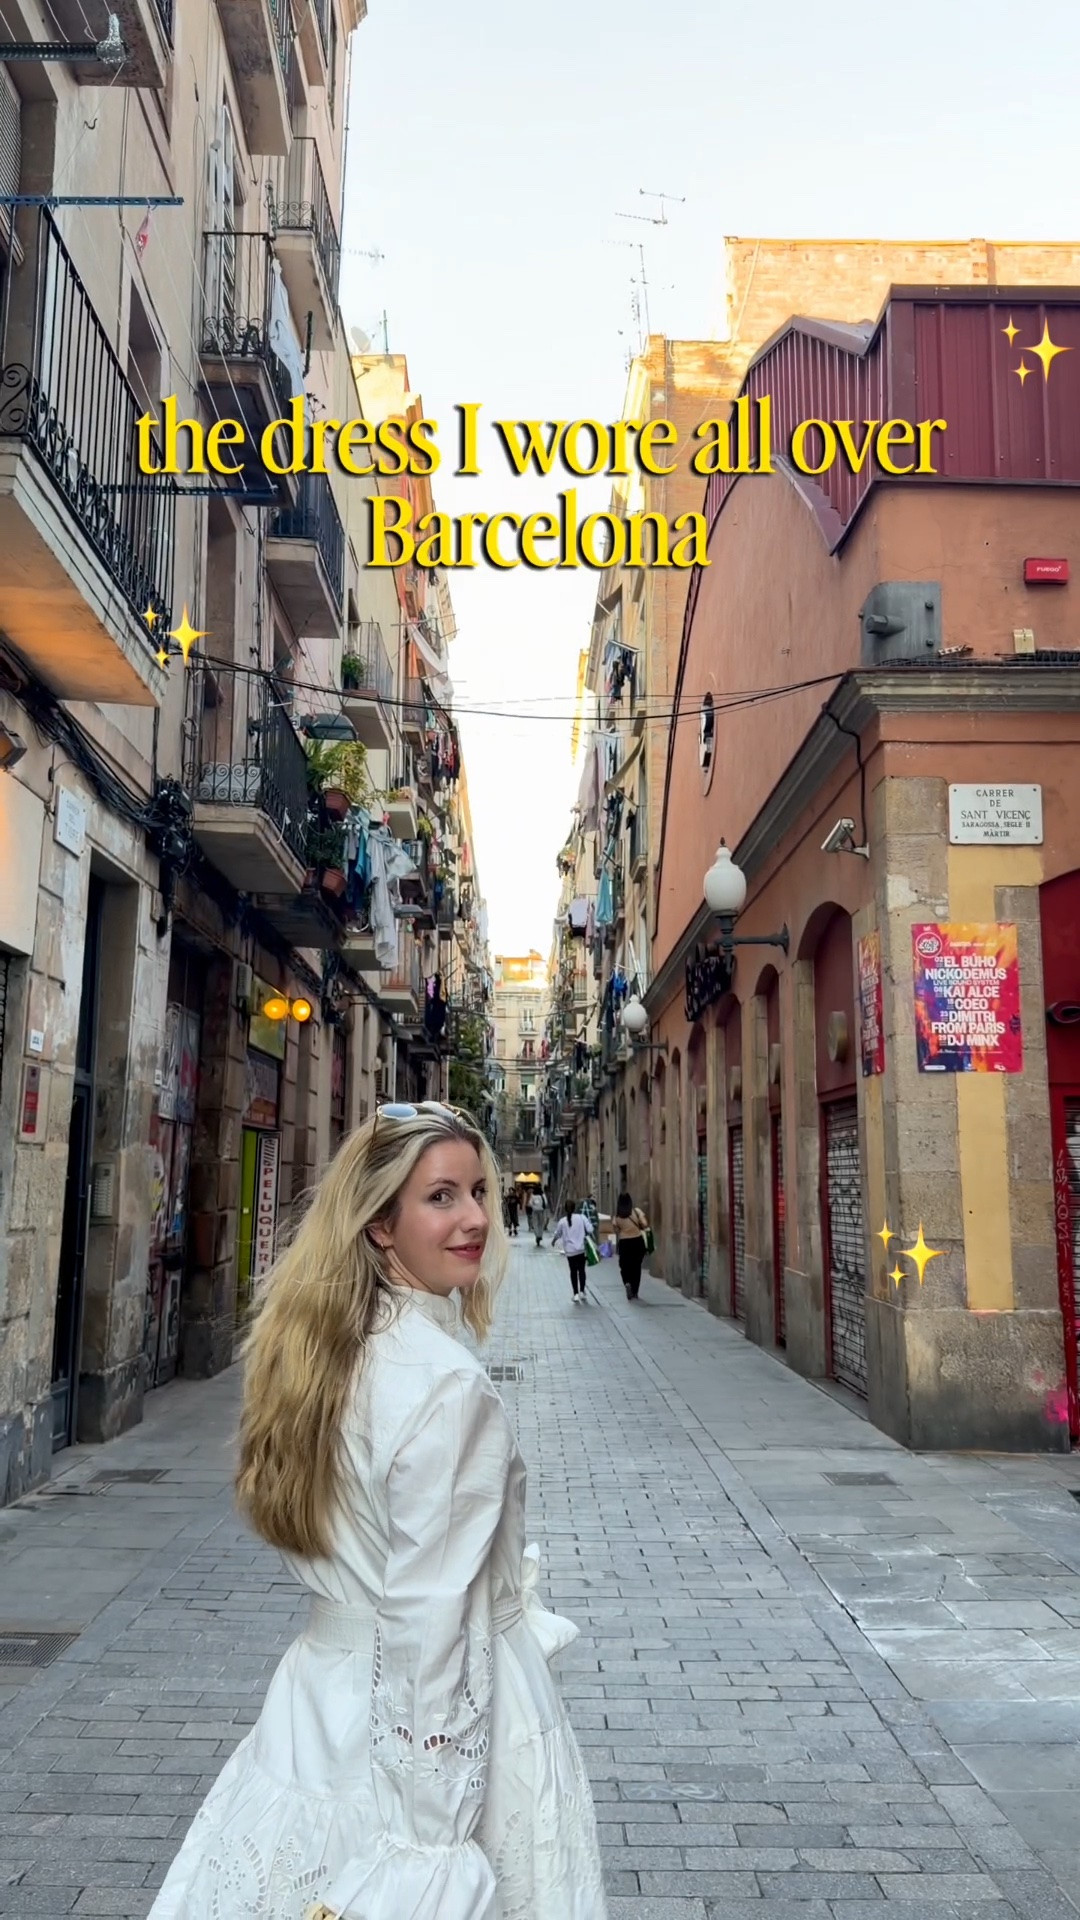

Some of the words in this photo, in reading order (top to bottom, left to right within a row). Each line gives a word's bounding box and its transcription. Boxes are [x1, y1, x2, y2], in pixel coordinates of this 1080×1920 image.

[976, 789, 1014, 797] CARRER
[961, 810, 988, 819] SANT
[996, 810, 1031, 820] VICENÇ
[983, 829, 1010, 837] MÀRTIR
[943, 956, 959, 967] EL
[961, 953, 996, 967] BÚHO
[925, 968, 1007, 980] NICKODEMUS
[943, 986, 965, 997] KAI
[967, 986, 1000, 998] ALCE
[954, 998, 988, 1010] COEO
[948, 1010, 996, 1022] DIMITRI
[932, 1022, 967, 1033] FROM
[969, 1022, 1005, 1034] PARIS
[947, 1034, 964, 1046] DJ
[966, 1034, 999, 1046] MINX
